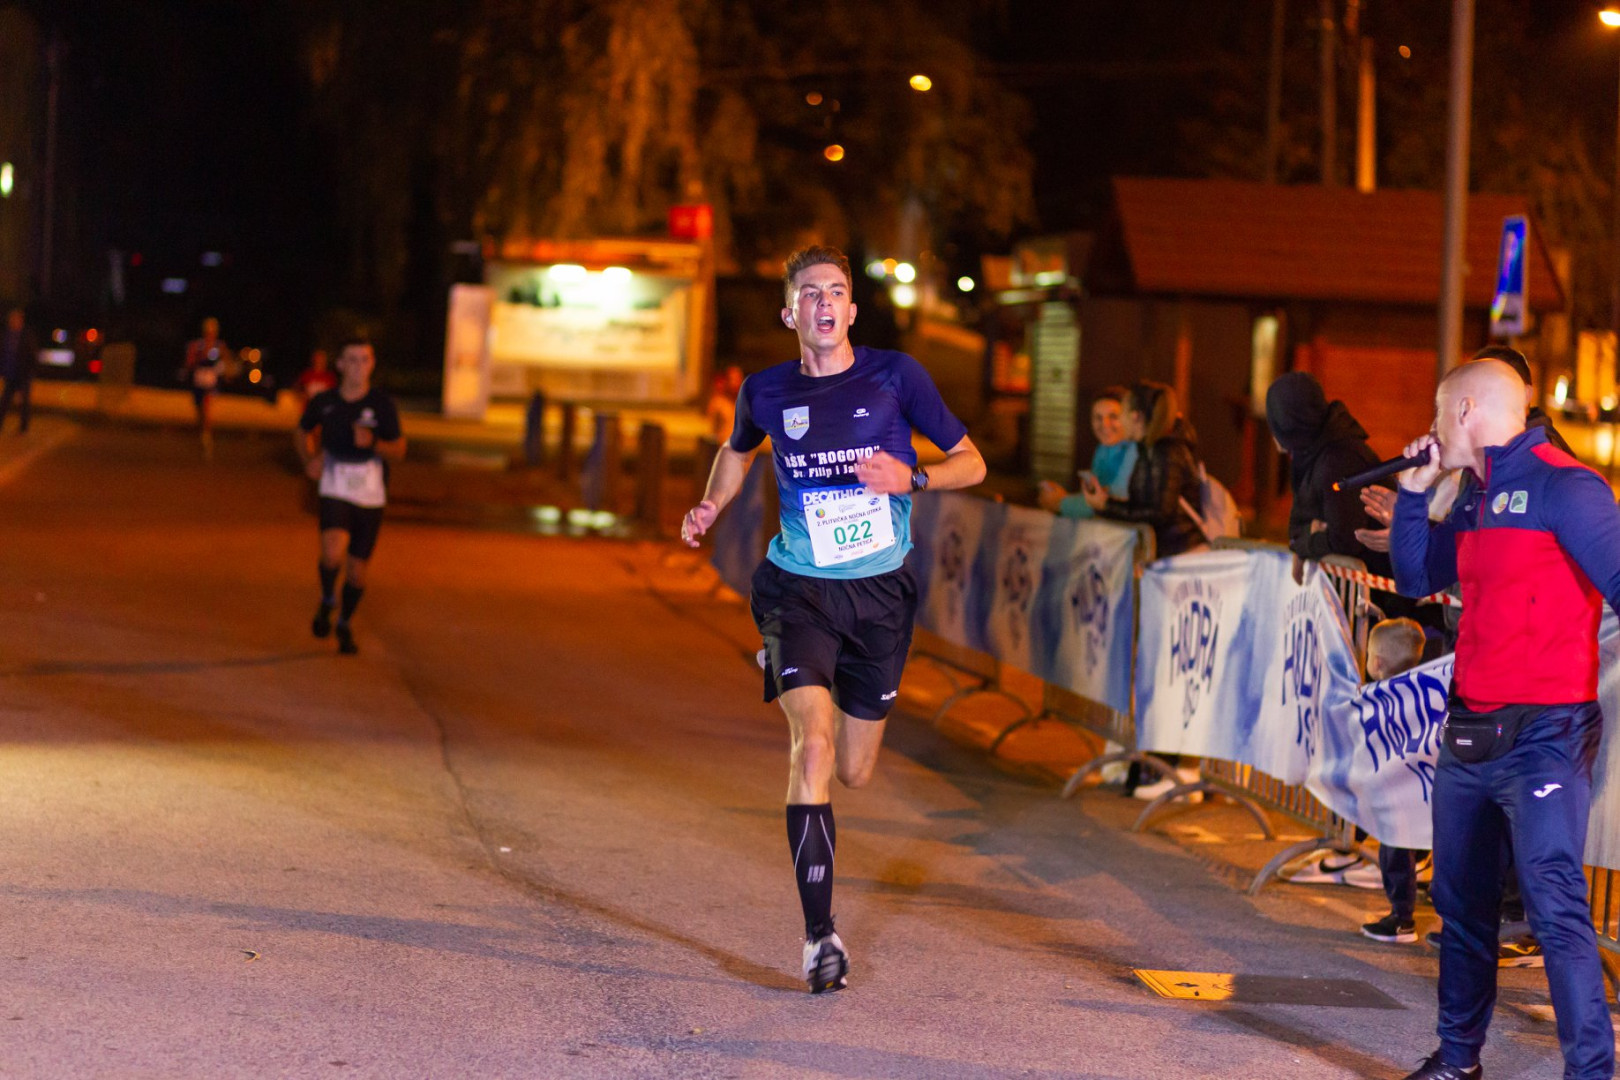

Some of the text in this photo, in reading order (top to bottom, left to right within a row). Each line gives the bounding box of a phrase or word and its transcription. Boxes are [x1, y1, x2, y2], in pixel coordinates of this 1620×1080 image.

[808, 467, 832, 478] Filip
[835, 465, 841, 475] i
[834, 520, 873, 545] 022
